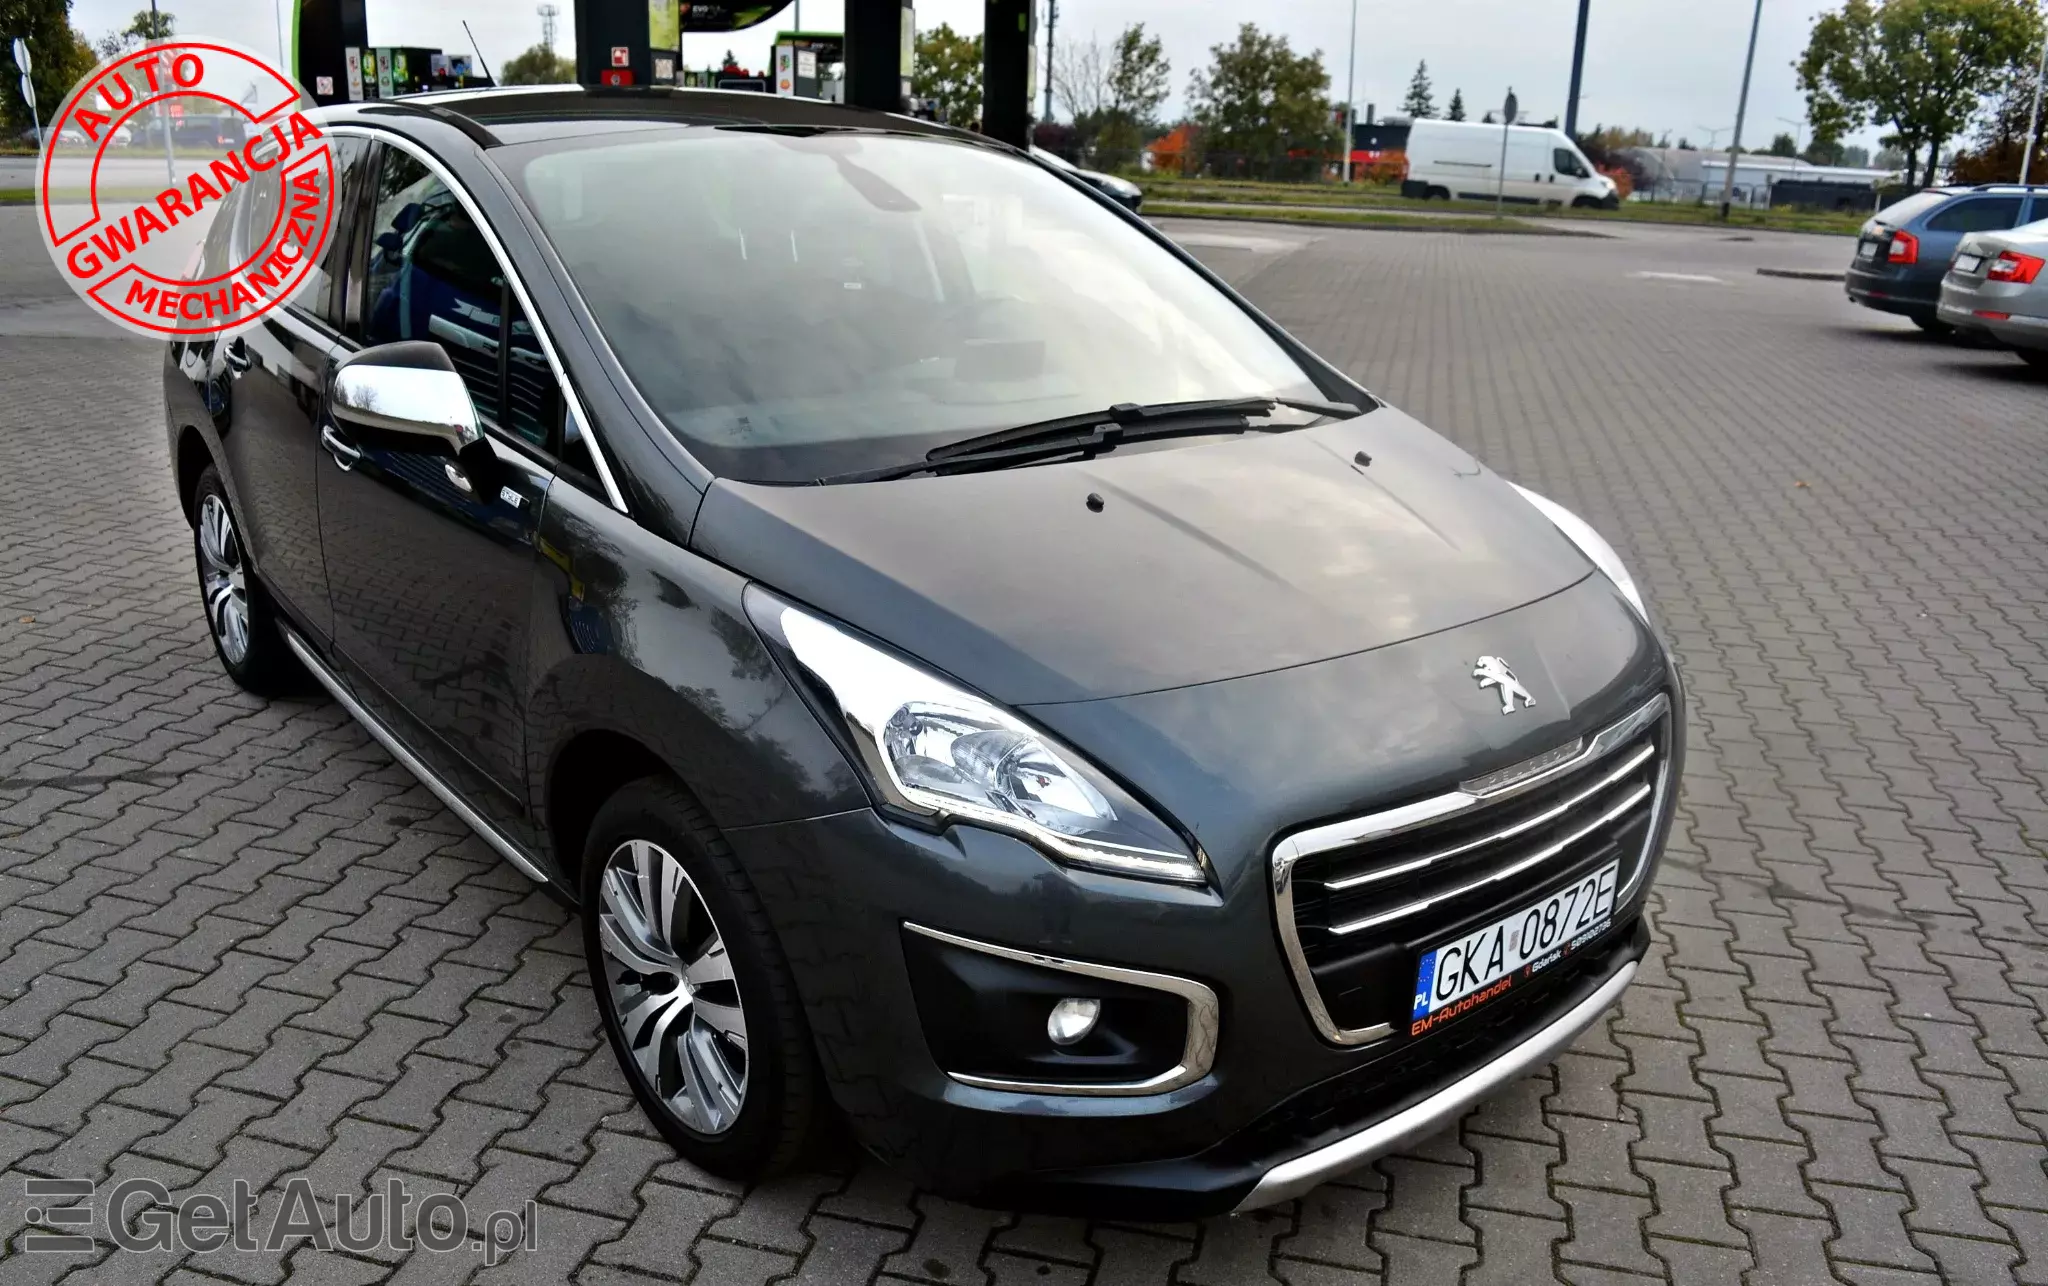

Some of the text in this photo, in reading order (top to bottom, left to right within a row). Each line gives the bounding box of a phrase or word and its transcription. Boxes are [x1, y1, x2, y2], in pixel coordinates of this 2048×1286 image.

[1435, 864, 1617, 1001] GKA 0872E
[1411, 974, 1513, 1037] EM-Autohandel
[1413, 991, 1429, 1011] PL
